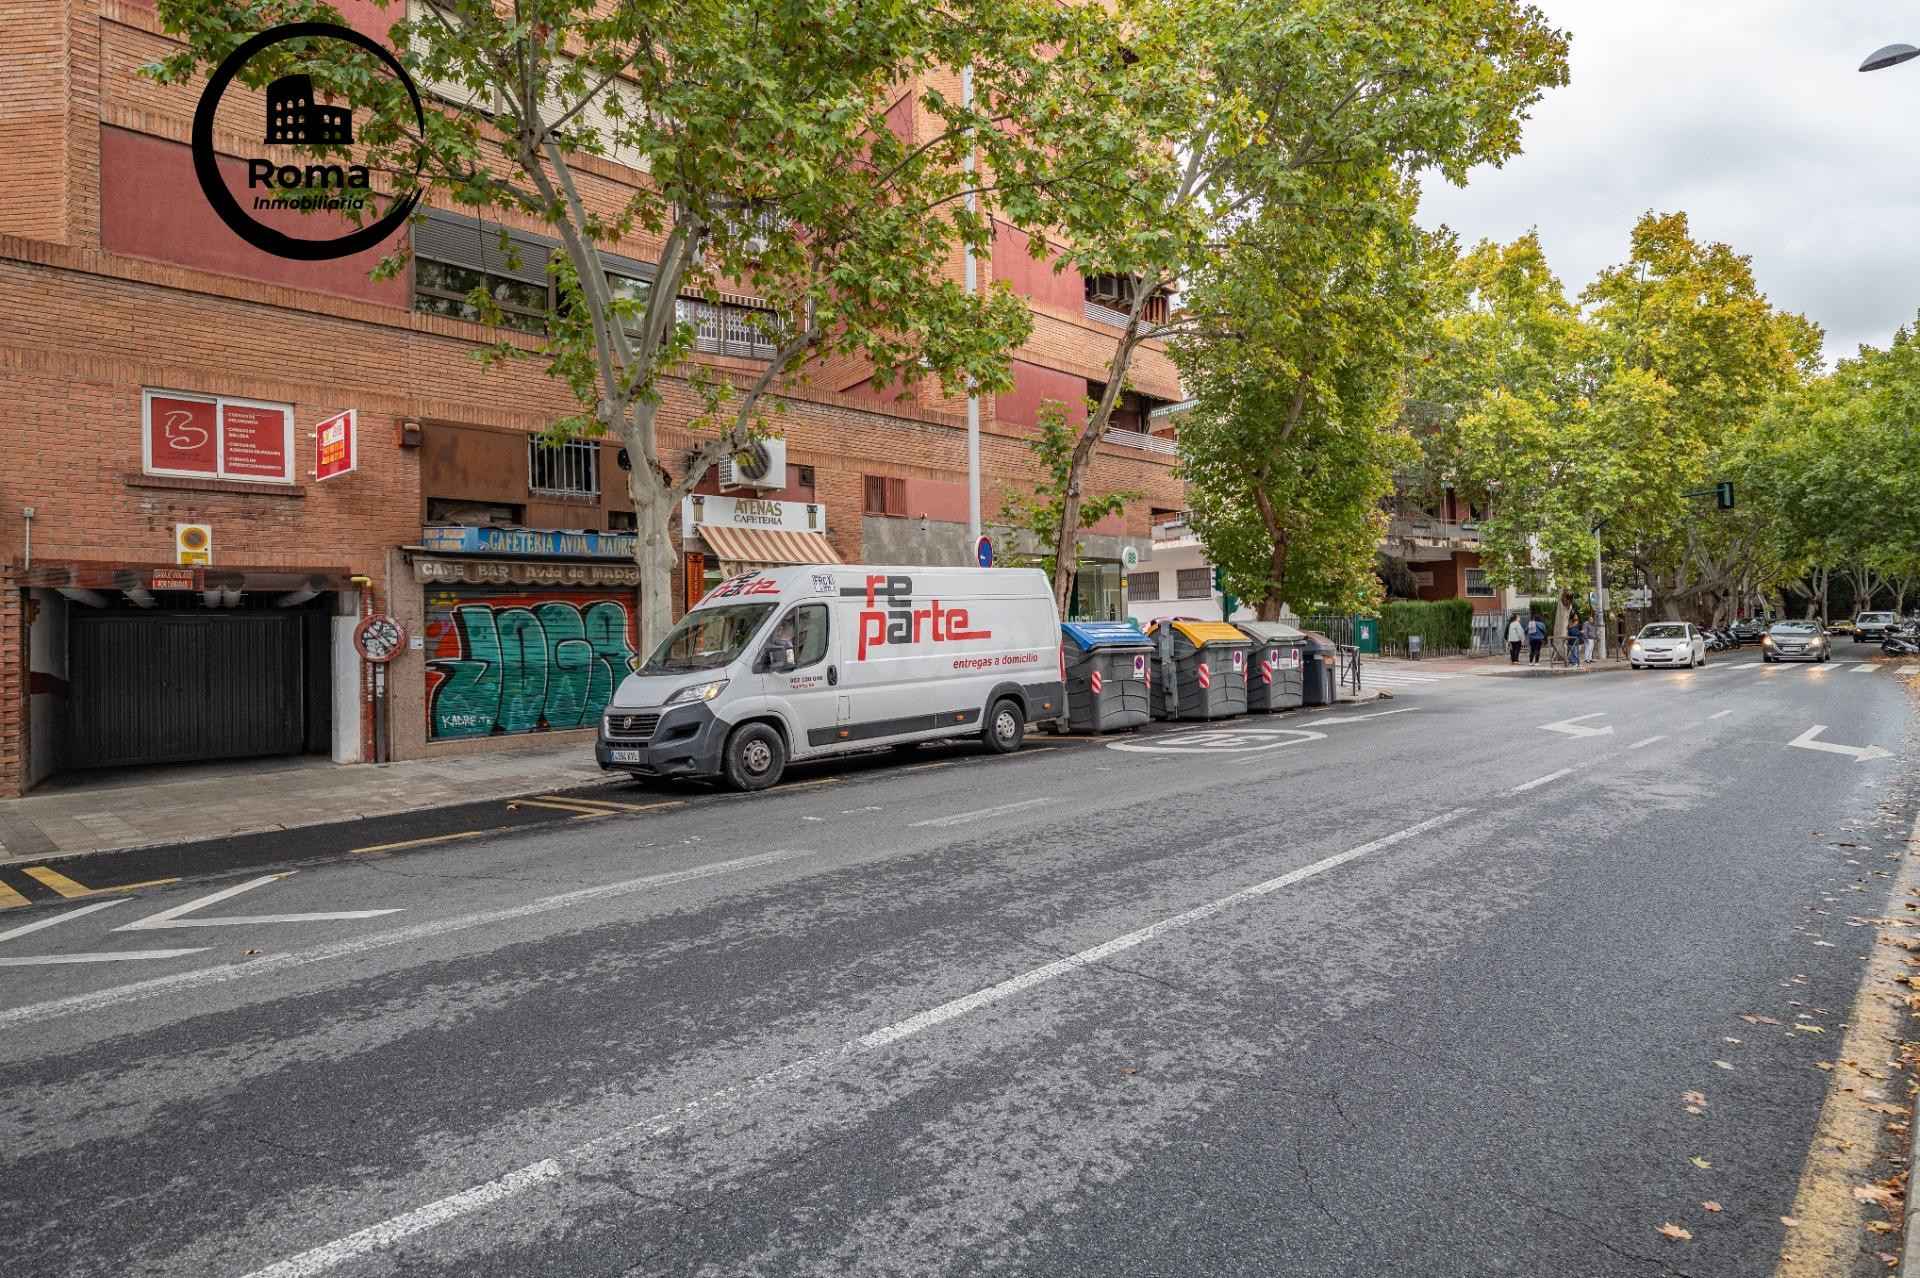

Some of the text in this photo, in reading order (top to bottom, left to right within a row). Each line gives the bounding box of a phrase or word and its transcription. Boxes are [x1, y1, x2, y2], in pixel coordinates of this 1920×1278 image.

[735, 499, 783, 517] ATENAS
[734, 515, 783, 526] CAFETERIA
[489, 530, 554, 553] CAFETERIA
[478, 564, 509, 579] BAR
[866, 575, 912, 608] re
[858, 600, 991, 661] parte
[953, 653, 1038, 669] entregas a domicilio
